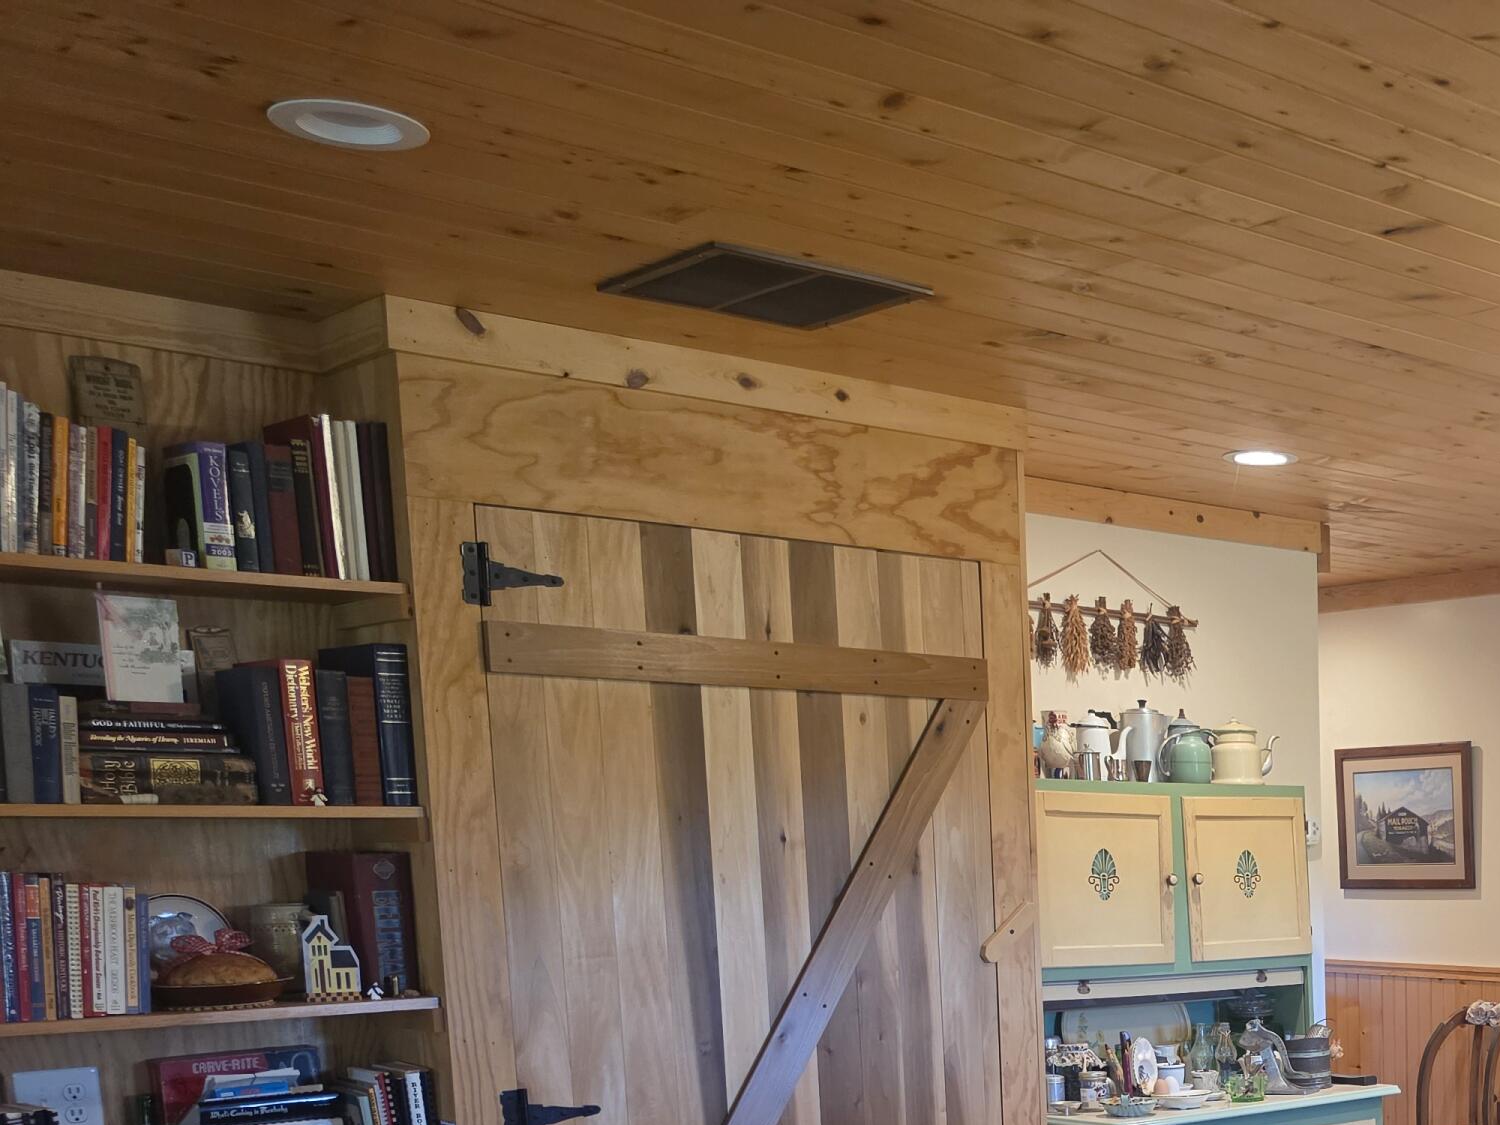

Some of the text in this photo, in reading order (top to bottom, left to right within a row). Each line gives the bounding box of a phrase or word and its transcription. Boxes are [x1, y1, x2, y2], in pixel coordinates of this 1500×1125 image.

[209, 455, 225, 522] KOVELS
[185, 551, 194, 566] P
[285, 664, 298, 721] Dictionary
[91, 719, 113, 727] GOD
[123, 720, 166, 728] FAITHFUL
[302, 714, 314, 740] New
[304, 740, 319, 770] World
[101, 760, 121, 794] Holy
[119, 760, 138, 796] Bible
[54, 887, 64, 924] Dining
[192, 1057, 260, 1074] CARVE-RITE
[411, 1082, 420, 1109] RIVER
